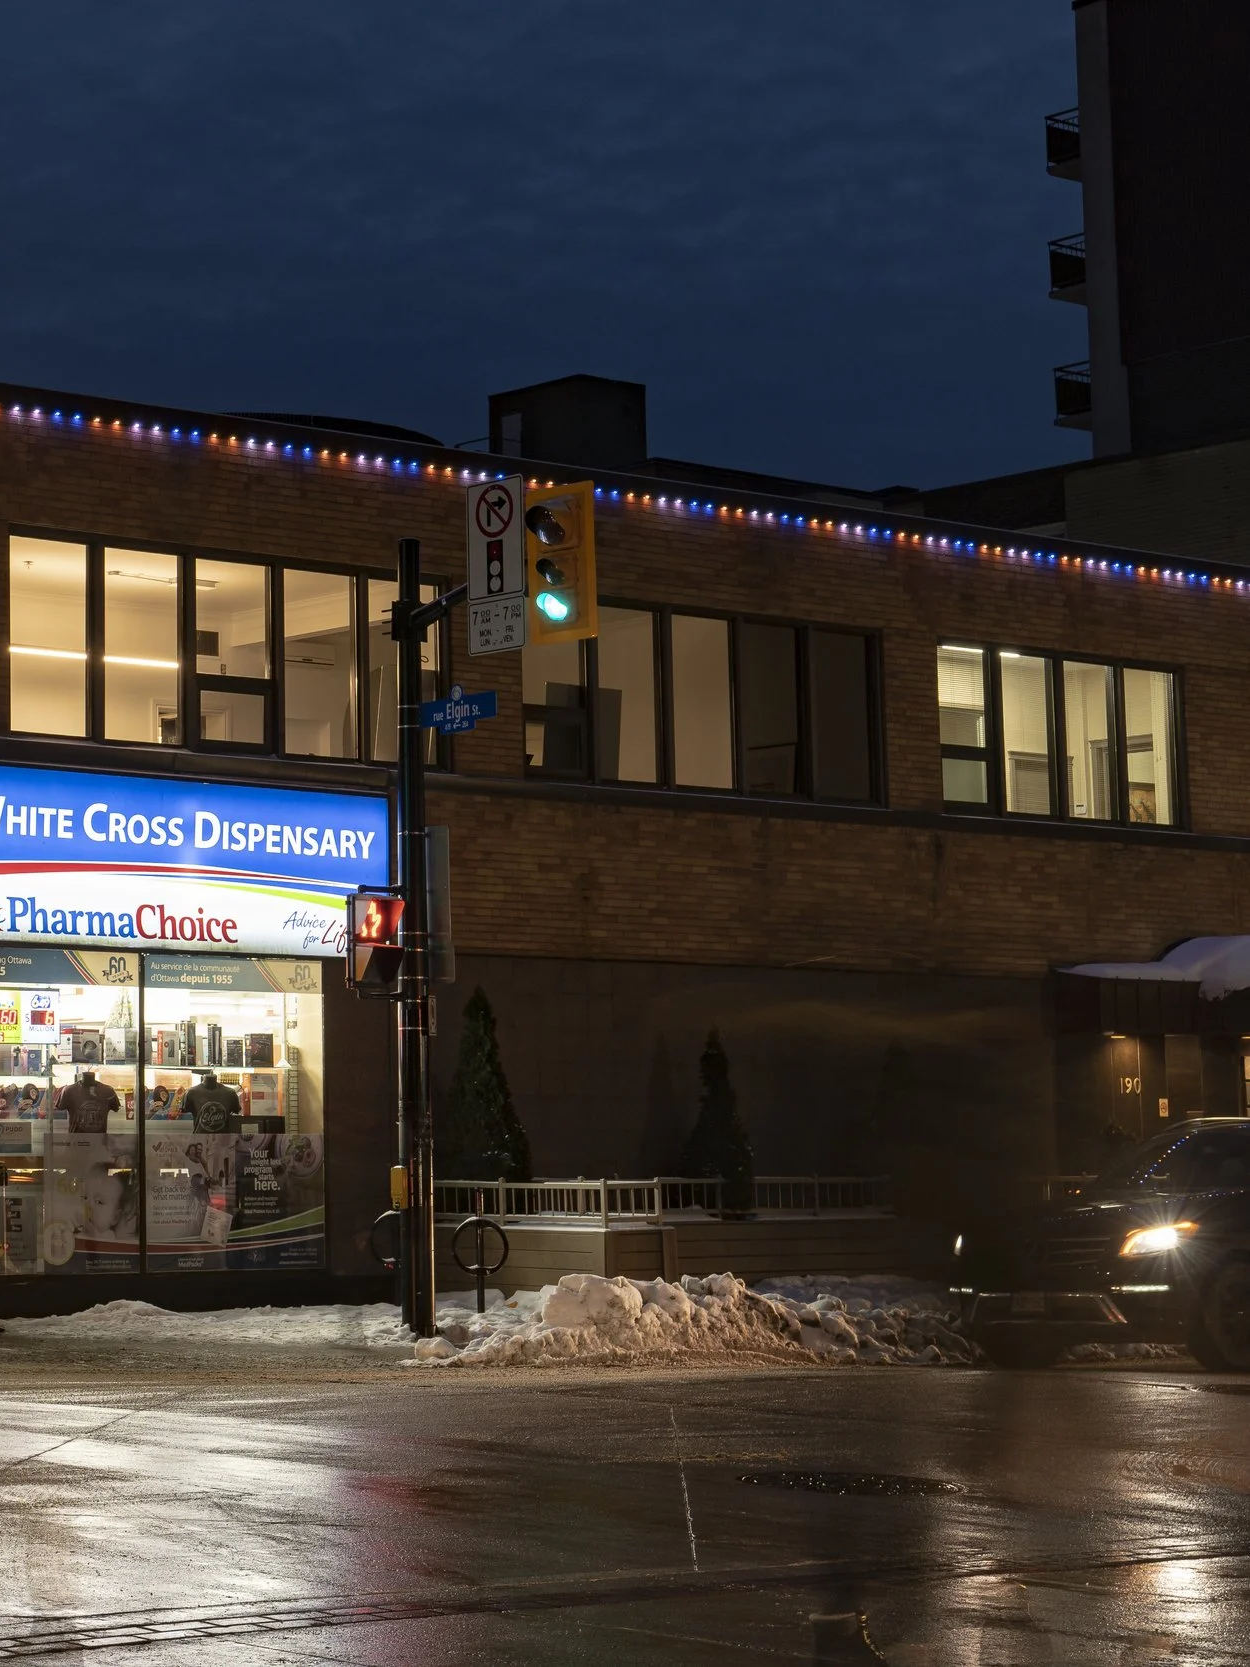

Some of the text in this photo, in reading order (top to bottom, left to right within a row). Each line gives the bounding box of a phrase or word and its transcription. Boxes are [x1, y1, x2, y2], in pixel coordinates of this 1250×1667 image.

[472, 611, 478, 626] 7
[503, 606, 509, 620] 7
[433, 700, 481, 722] rue Elgin St.
[83, 803, 184, 847] CROSS
[194, 811, 376, 859] DISPENSARY
[6, 896, 238, 943] PharmaChoice
[283, 911, 327, 931] Advice
[303, 919, 348, 954] for Lif
[7, 956, 32, 965] Ottawa
[161, 963, 183, 971] service
[184, 962, 192, 971] de
[192, 963, 199, 971] la
[200, 964, 240, 973] communauté
[108, 956, 126, 983] 60
[294, 964, 310, 990] 60
[150, 973, 233, 985] d'Ottawa depuis 1955
[0, 1010, 17, 1024] 60
[26, 1011, 54, 1024] $ 6
[1120, 1077, 1142, 1095] 190
[250, 1150, 268, 1158] Your
[244, 1166, 272, 1175] program
[250, 1159, 272, 1167] weight
[254, 1179, 281, 1191] here.
